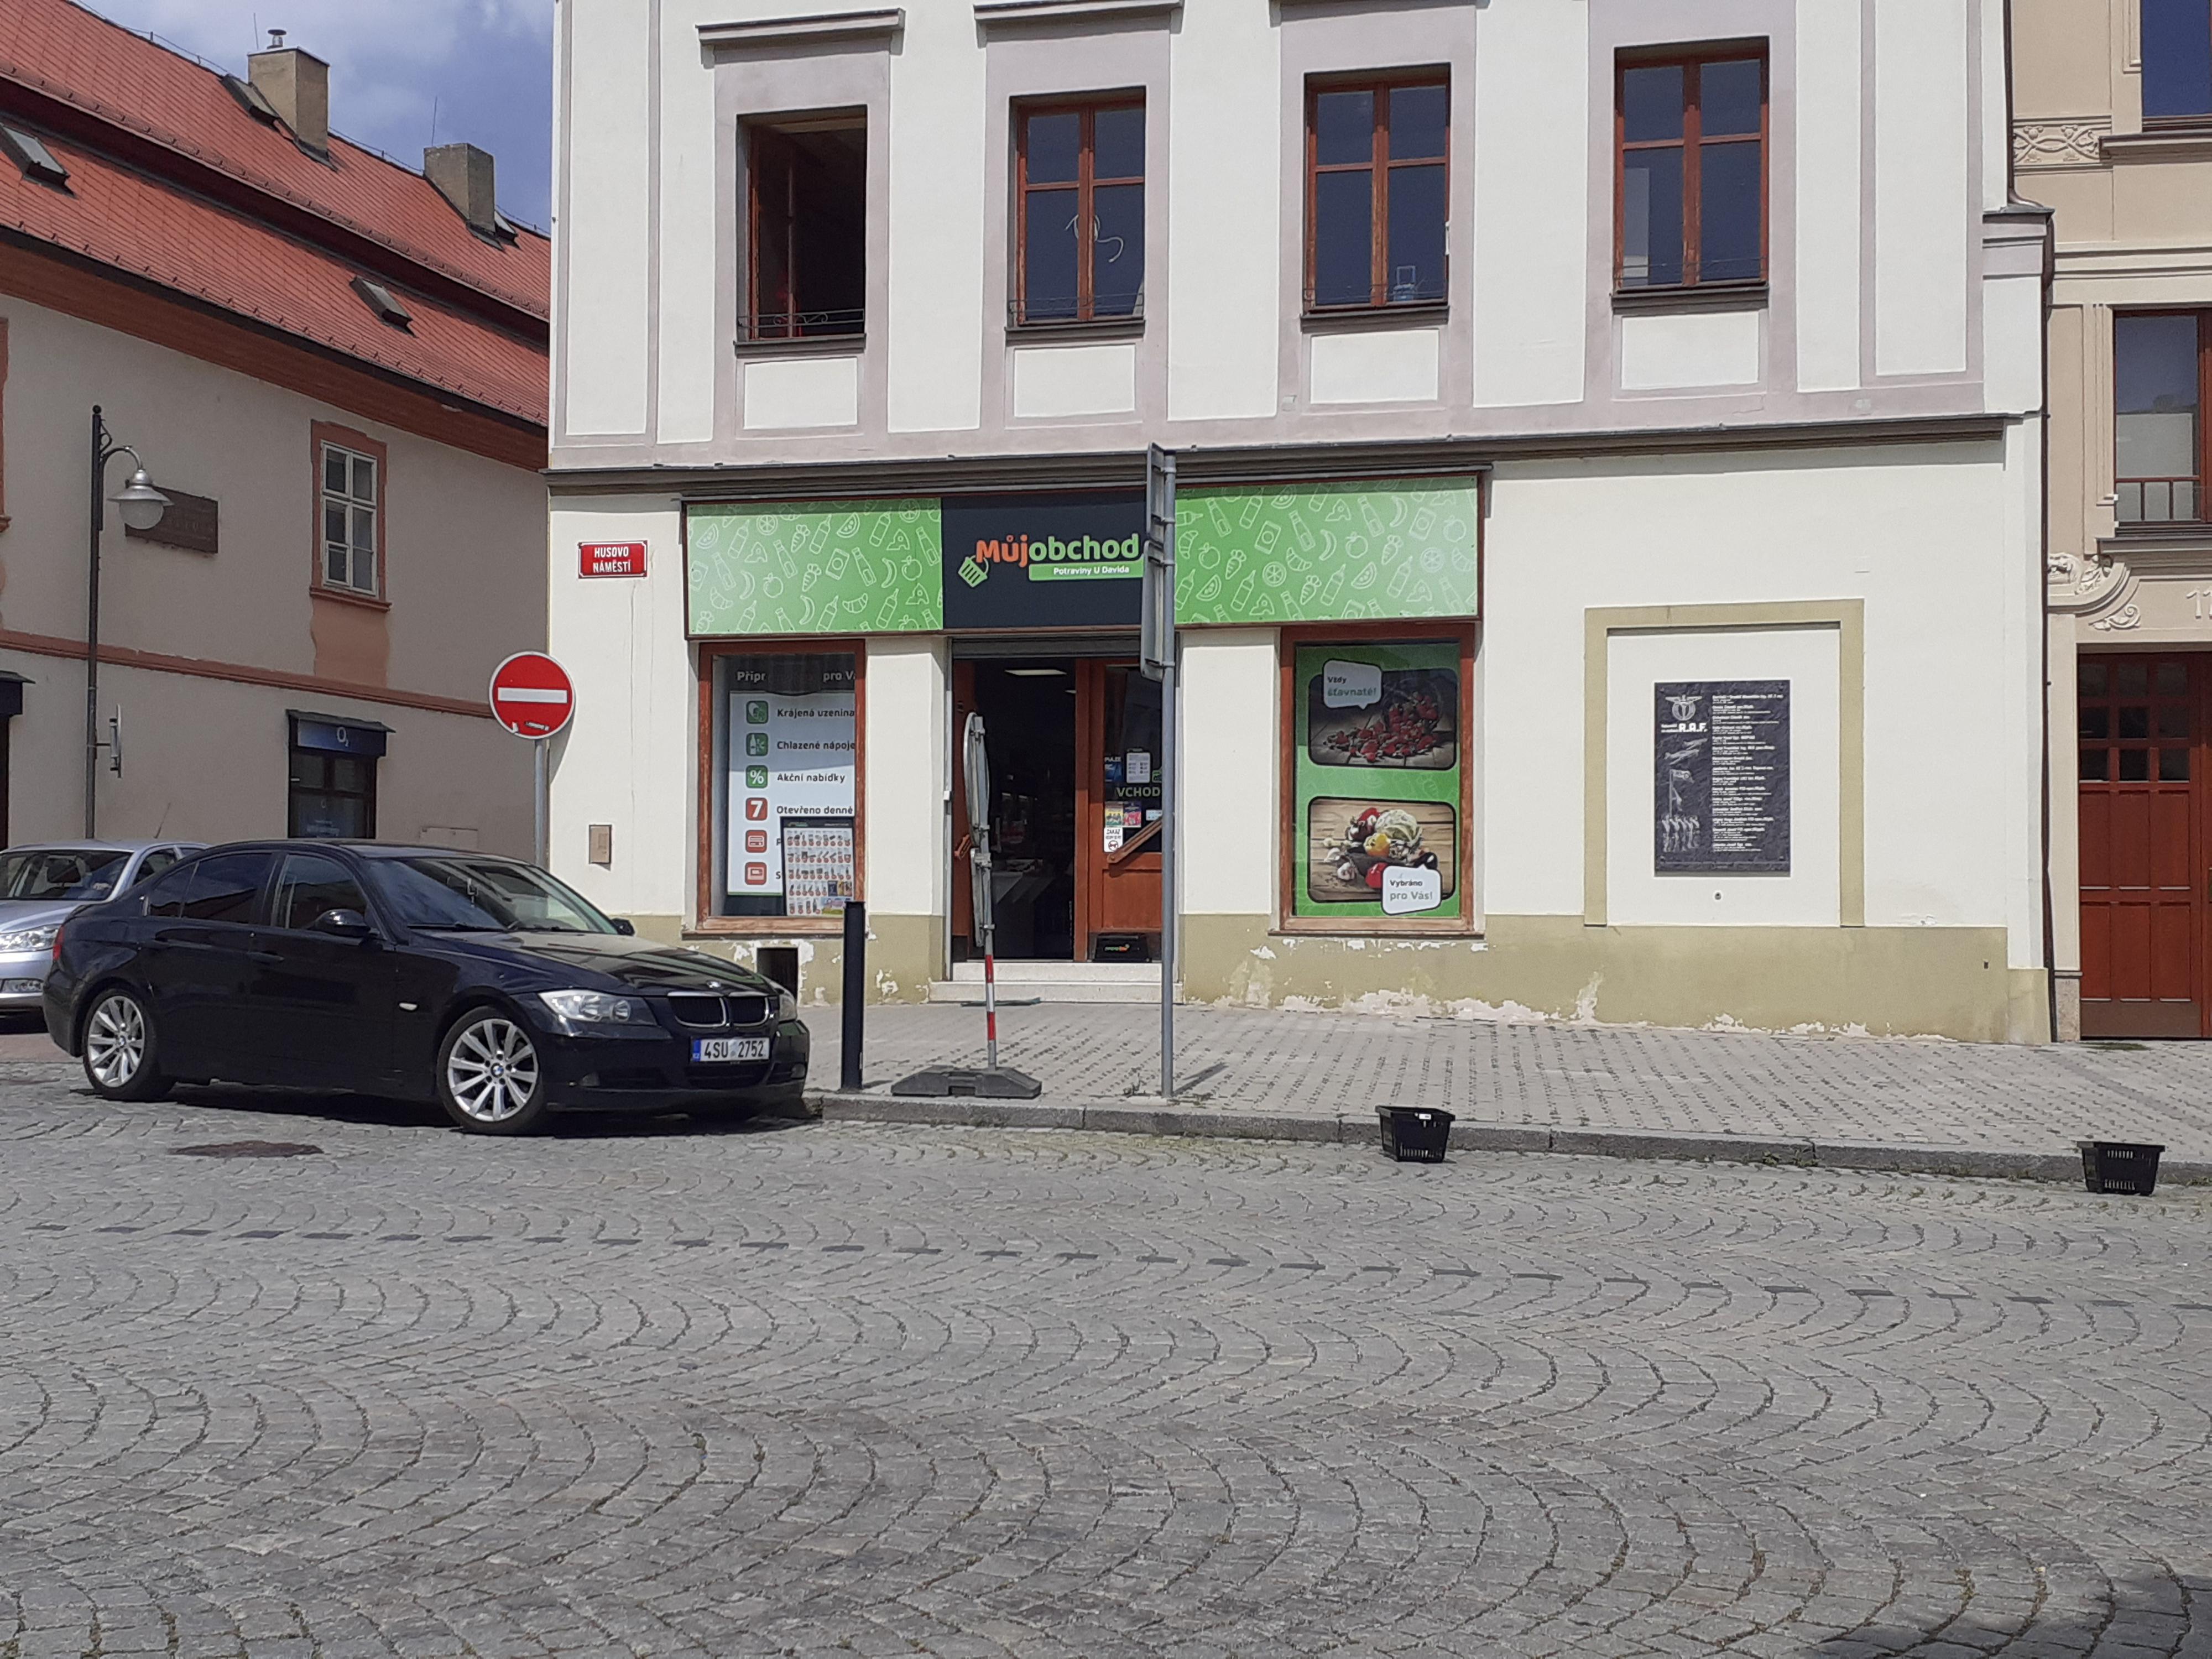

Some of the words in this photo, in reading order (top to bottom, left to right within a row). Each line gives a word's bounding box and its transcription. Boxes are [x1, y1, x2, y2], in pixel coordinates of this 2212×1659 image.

[594, 546, 629, 558] HUSOVO
[592, 559, 632, 573] NÁMĚSTÍ
[1053, 567, 1092, 575] Potraviny
[1102, 566, 1130, 574] Davida
[823, 672, 843, 682] pro
[777, 708, 815, 718] Krájená
[776, 741, 820, 750] Chlazené
[806, 773, 845, 783] nabídky
[1116, 787, 1161, 797] VCHOD
[750, 801, 763, 818] 7
[776, 806, 821, 814] Otevřeno
[823, 806, 853, 814] denně
[1390, 879, 1423, 888] Vybráno
[1390, 893, 1407, 901] pro
[1411, 891, 1432, 900] Vás!
[705, 1042, 728, 1058] 4SU
[738, 1040, 764, 1058] 2752
